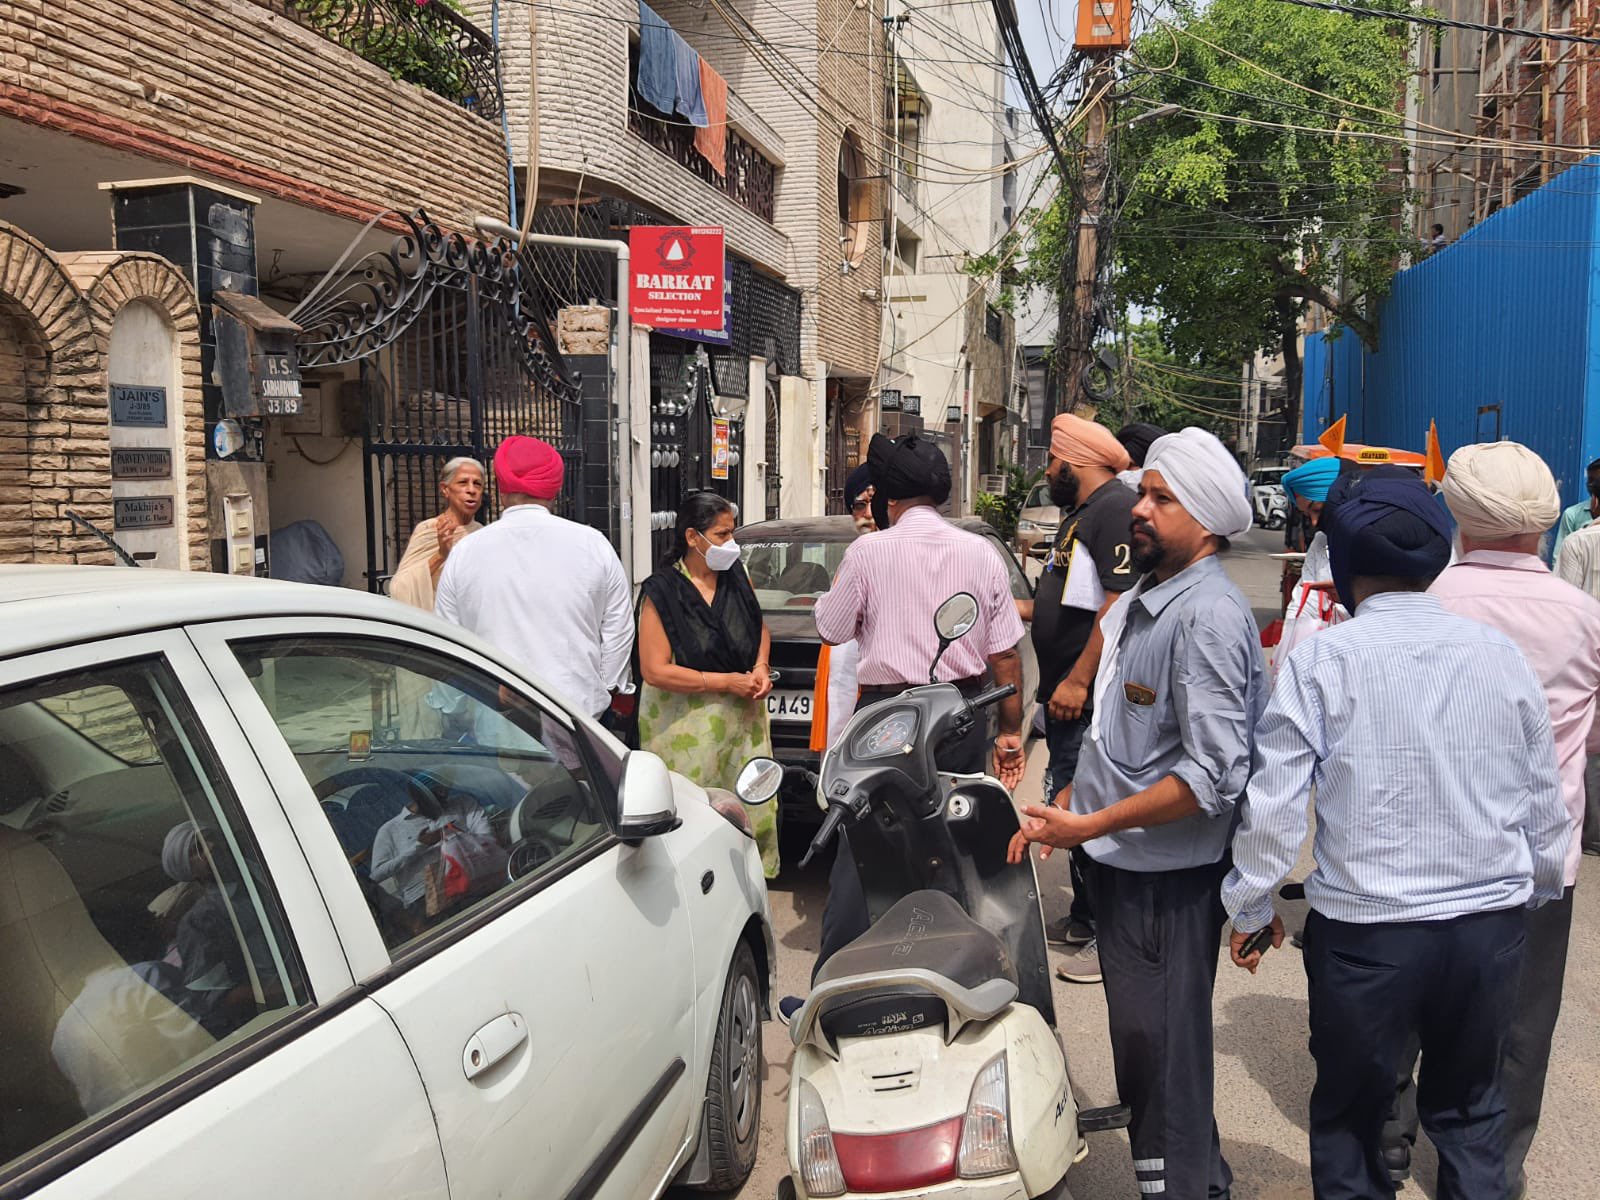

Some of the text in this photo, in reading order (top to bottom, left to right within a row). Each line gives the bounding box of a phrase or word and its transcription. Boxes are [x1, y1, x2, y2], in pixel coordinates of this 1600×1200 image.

[636, 273, 715, 290] BARKAT
[648, 291, 702, 300] SELECTION
[119, 390, 160, 403] JAIN'S
[124, 502, 165, 513] Makhija's
[1112, 543, 1132, 574] 2
